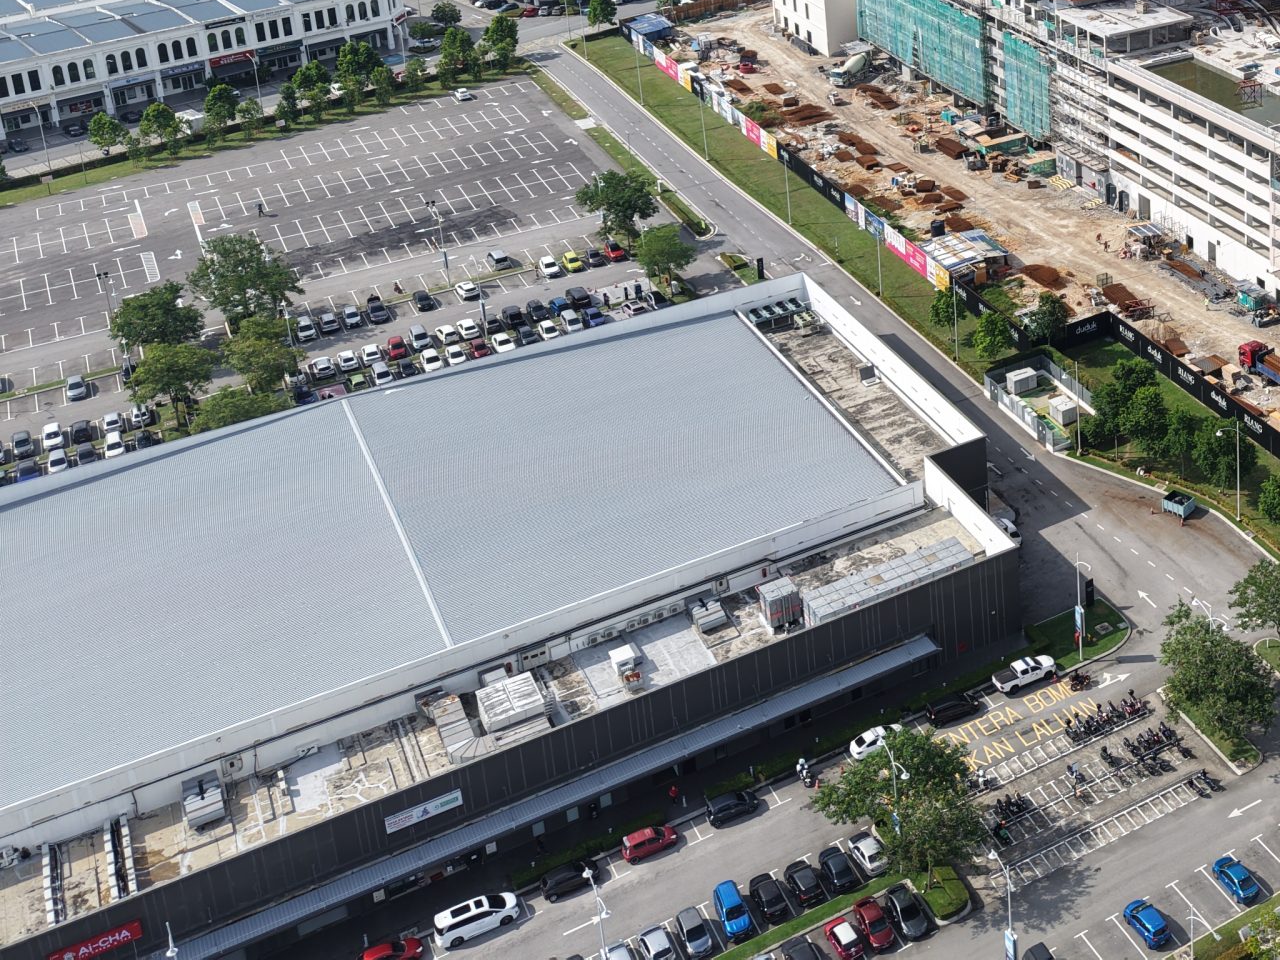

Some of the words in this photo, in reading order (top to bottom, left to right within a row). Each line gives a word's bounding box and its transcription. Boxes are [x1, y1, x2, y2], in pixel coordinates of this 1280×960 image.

[1075, 321, 1097, 335] duduk
[1177, 366, 1195, 384] RIANG
[1244, 413, 1263, 433] RIANG
[79, 929, 131, 956] Ai-CHA
